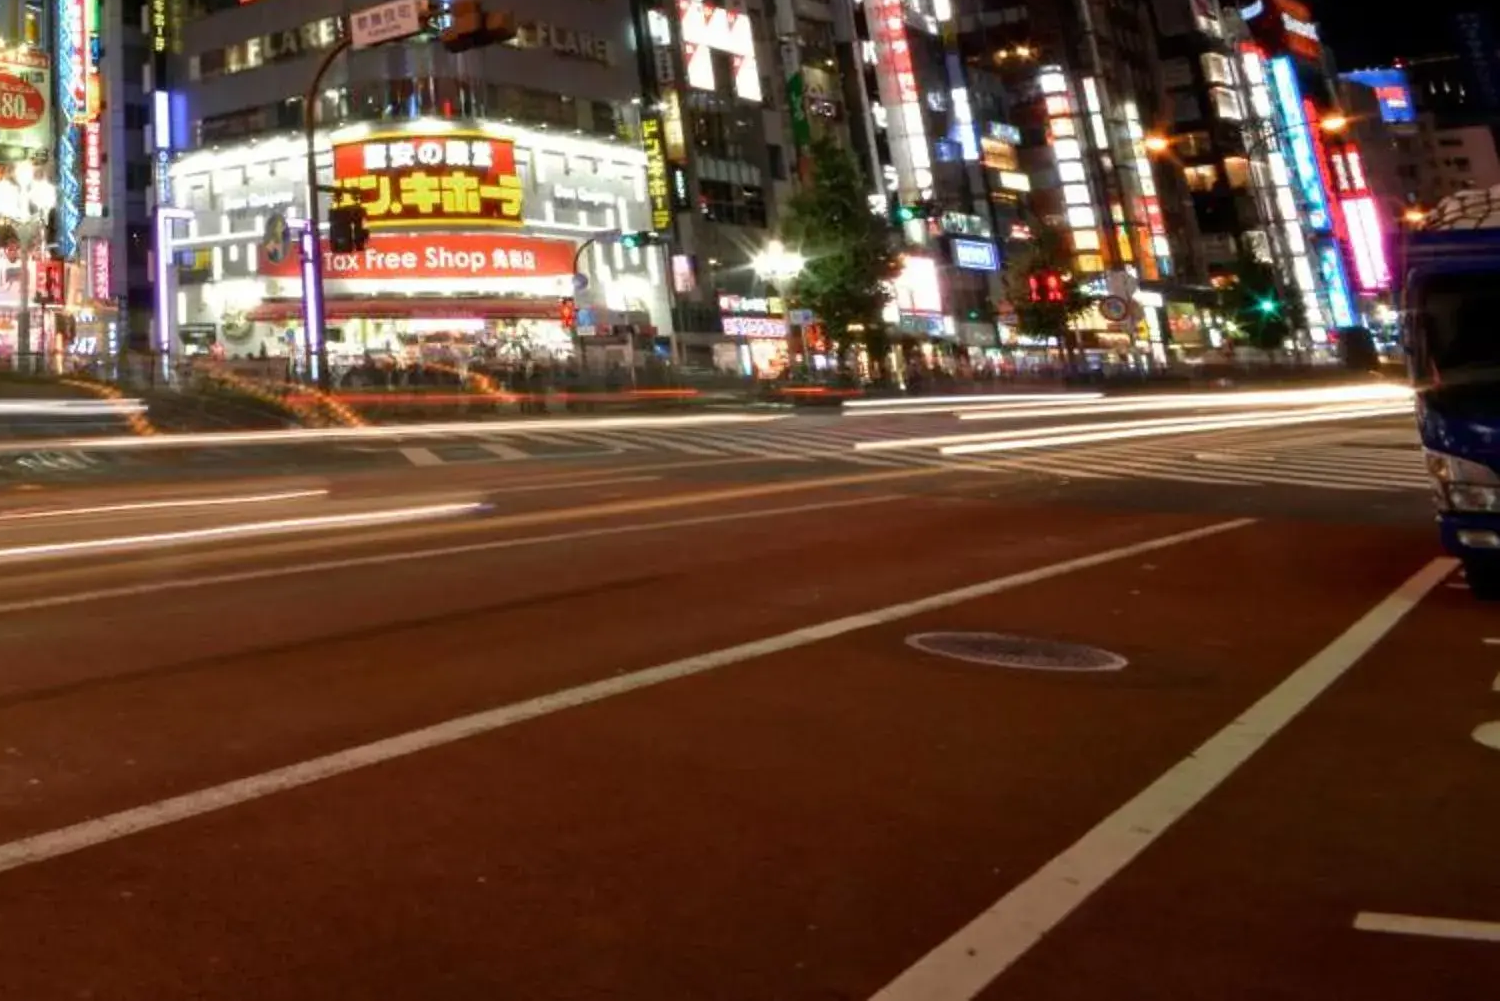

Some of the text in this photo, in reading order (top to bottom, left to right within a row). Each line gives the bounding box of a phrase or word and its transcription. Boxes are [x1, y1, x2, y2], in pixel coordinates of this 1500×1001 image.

[324, 251, 359, 271] Tax
[365, 249, 418, 270] Free
[424, 246, 486, 272] Shop
